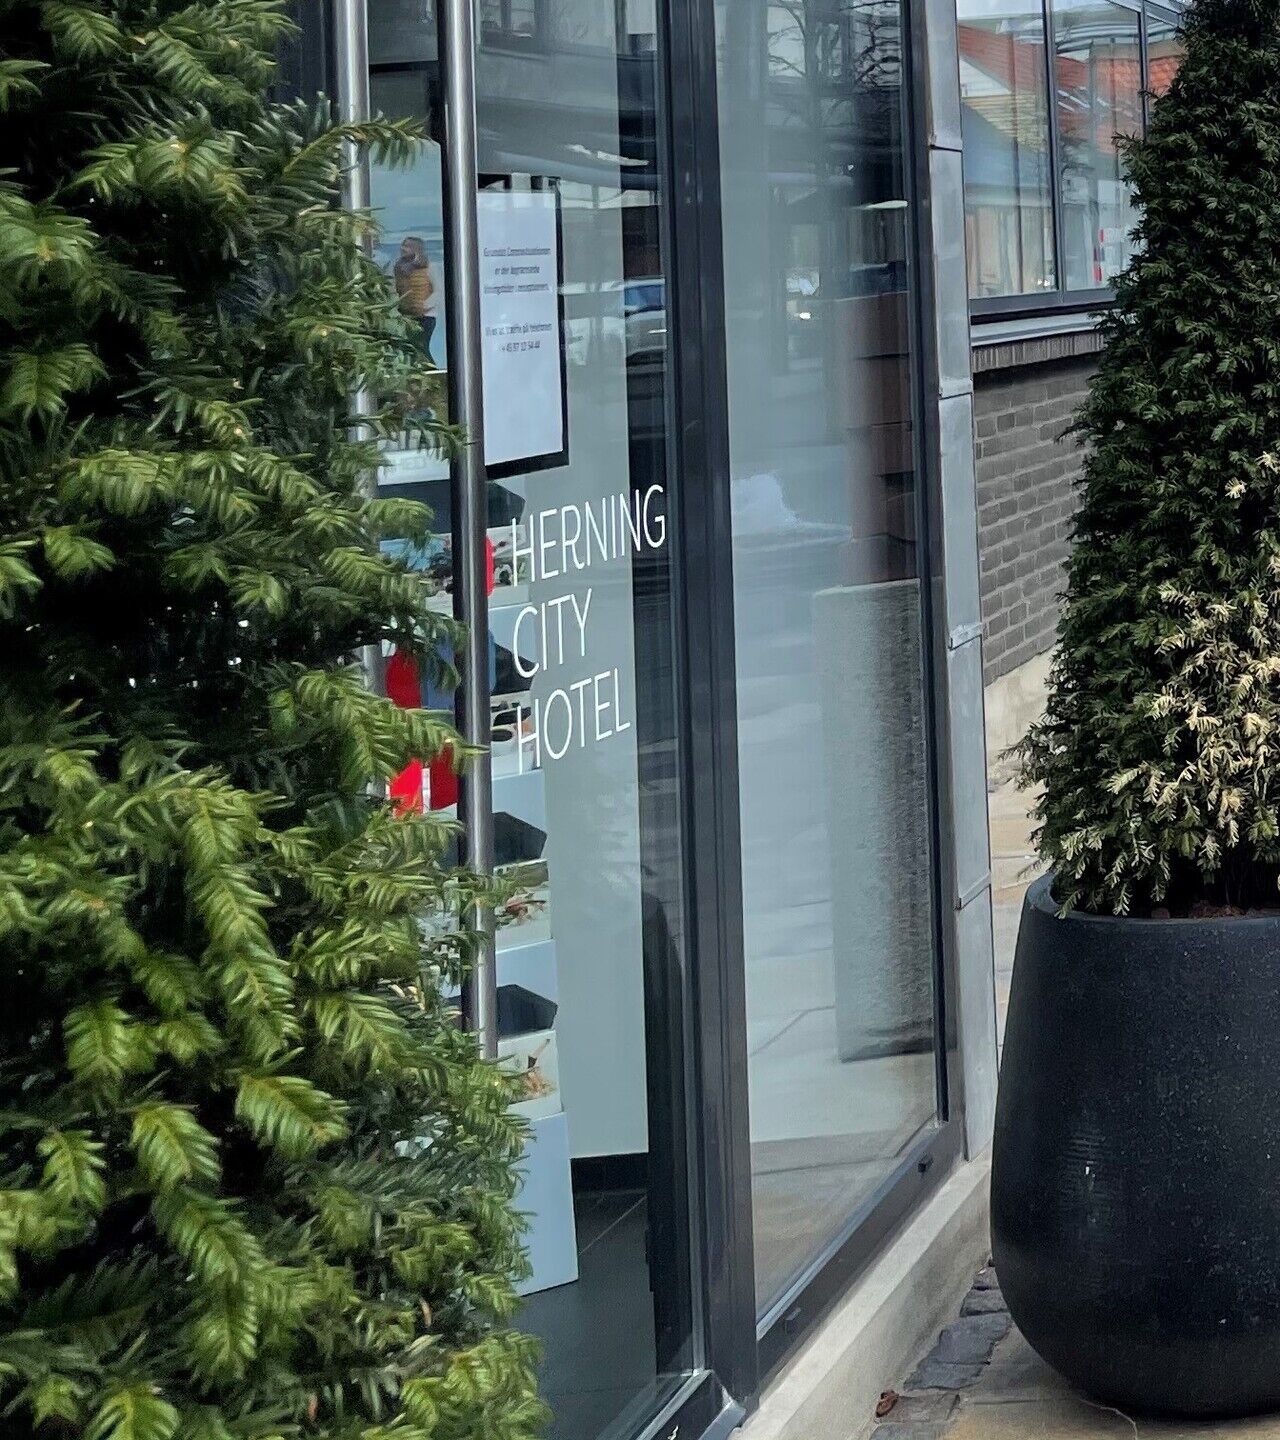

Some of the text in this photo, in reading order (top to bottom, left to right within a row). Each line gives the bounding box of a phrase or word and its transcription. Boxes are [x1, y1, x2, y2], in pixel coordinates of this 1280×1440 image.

[511, 484, 666, 587] HERNING
[513, 588, 592, 678] CITY
[517, 667, 631, 775] HOTEL
